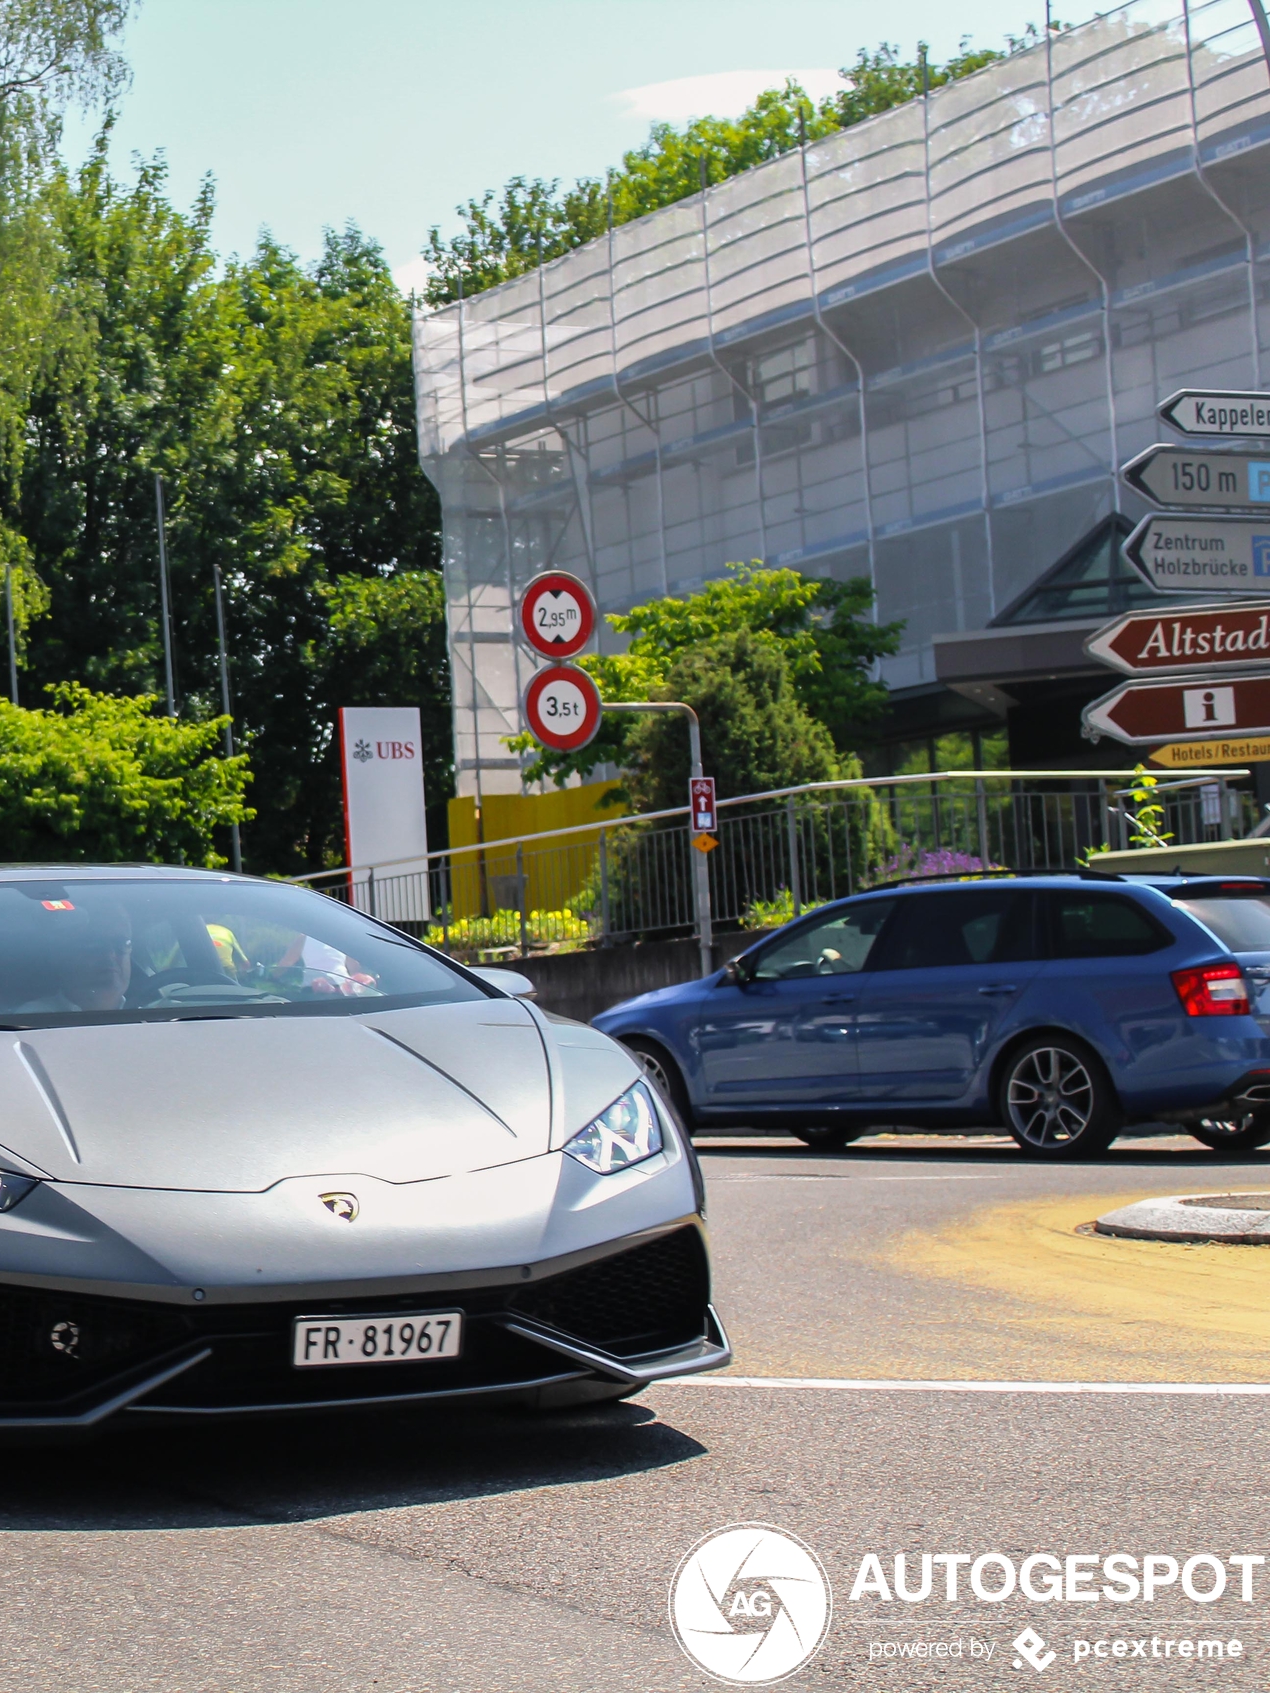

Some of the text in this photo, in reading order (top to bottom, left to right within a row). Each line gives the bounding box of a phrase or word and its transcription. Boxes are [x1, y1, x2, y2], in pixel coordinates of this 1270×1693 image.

[1172, 462, 1210, 491] 150
[1218, 471, 1237, 492] m
[1153, 533, 1225, 551] Zentrum
[1154, 557, 1248, 576] Holzbrücke
[1137, 615, 1270, 658] Altstad
[375, 742, 415, 760] UBS
